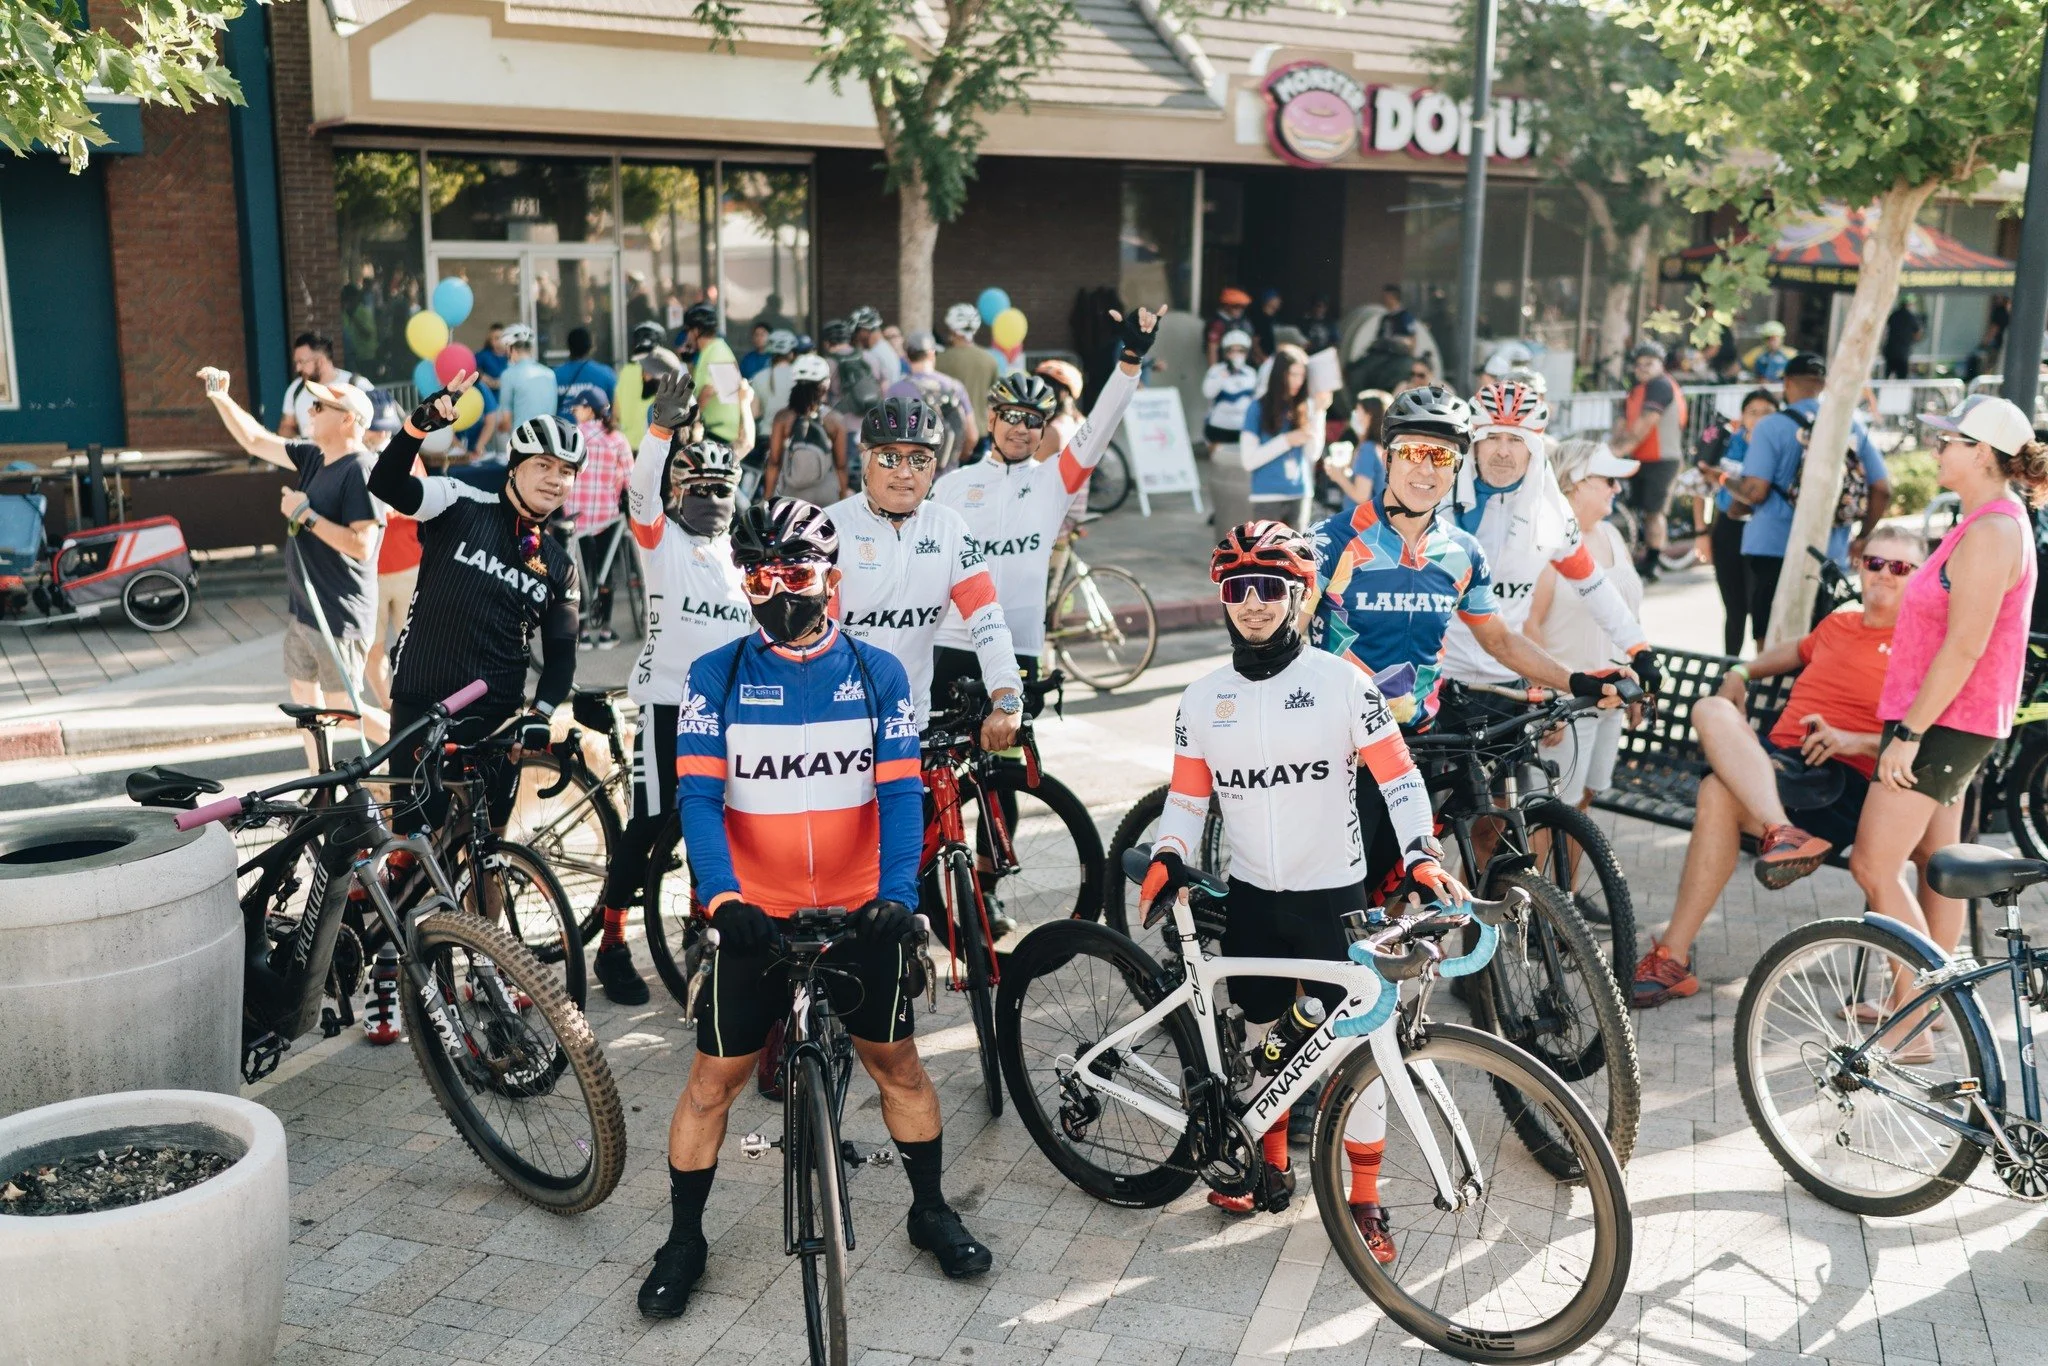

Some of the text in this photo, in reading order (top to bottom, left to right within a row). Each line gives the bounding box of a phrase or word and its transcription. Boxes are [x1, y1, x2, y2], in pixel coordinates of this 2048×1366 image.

[1271, 66, 1366, 110] MONSTER
[1373, 87, 1549, 157] DONU
[974, 533, 1040, 556] KAYS
[453, 541, 548, 603] LAKAYS
[1355, 592, 1456, 613] LAKAYS
[1492, 582, 1533, 599] AYS
[844, 605, 942, 629] LAKAYS
[638, 594, 664, 685] Lakays
[1216, 692, 1238, 700] Rotary
[1284, 700, 1315, 710] LAKAYS
[884, 723, 919, 740] LAK
[1365, 709, 1394, 736] LAK
[735, 747, 873, 780] LAKAYS
[1215, 760, 1330, 789] LAKAYS
[1220, 791, 1231, 799] EST.
[294, 861, 329, 970] SPECIALIZED
[428, 1007, 463, 1052] FOX
